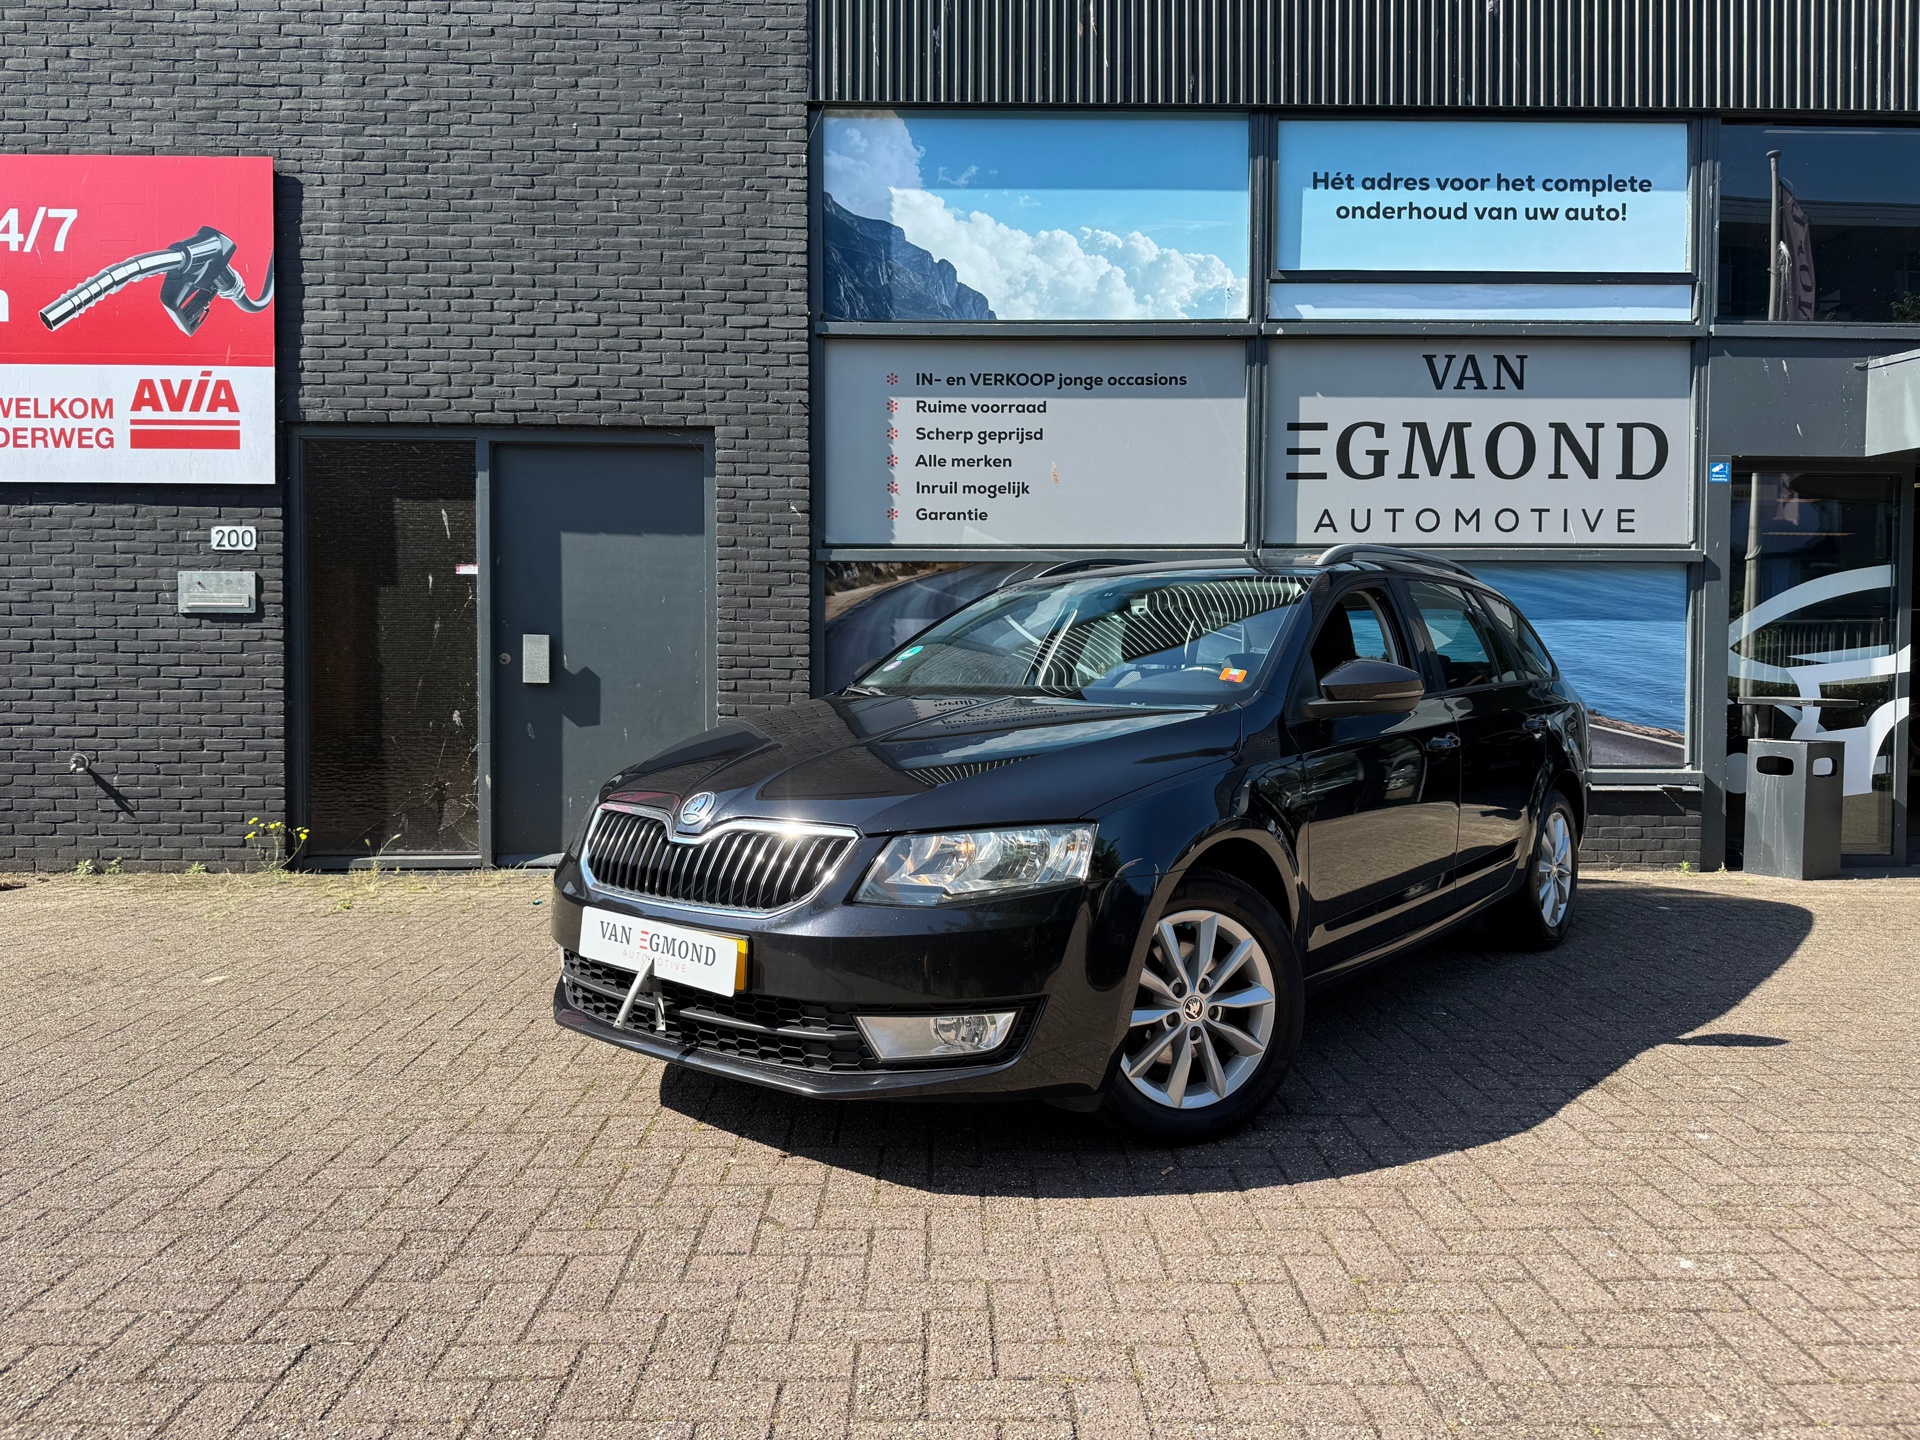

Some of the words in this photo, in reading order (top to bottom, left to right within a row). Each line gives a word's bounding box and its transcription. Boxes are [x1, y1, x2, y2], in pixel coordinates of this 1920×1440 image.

[1312, 172, 1354, 190] Hét
[1361, 172, 1430, 191] adres
[1436, 177, 1490, 191] voor
[1496, 174, 1535, 191] het
[1541, 174, 1652, 195] complete
[1336, 202, 1468, 220] onderhoud
[1474, 206, 1517, 220] van
[1525, 207, 1559, 221] uw
[1565, 203, 1627, 221] auto!
[916, 373, 942, 386] IN-
[946, 376, 966, 386] en
[969, 373, 1055, 387] VERKOOP
[1057, 373, 1103, 390] jonge
[1107, 373, 1187, 387] occasions
[1422, 355, 1528, 390] VAN
[916, 400, 967, 414] Ruime
[971, 400, 1047, 414] voorraad
[915, 427, 974, 444] Scherp
[978, 427, 1044, 445] geprijsd
[1286, 421, 1669, 480] EGMOND
[915, 454, 947, 468] Alle
[951, 454, 1012, 468] merken
[916, 481, 958, 495] Inruil
[962, 481, 1030, 499] mogelijk
[915, 507, 989, 521] Garantie
[1313, 507, 1636, 533] AUTOMOTIVE
[215, 529, 253, 548] 200
[600, 921, 632, 945] VAN
[640, 930, 716, 966] EGMOND
